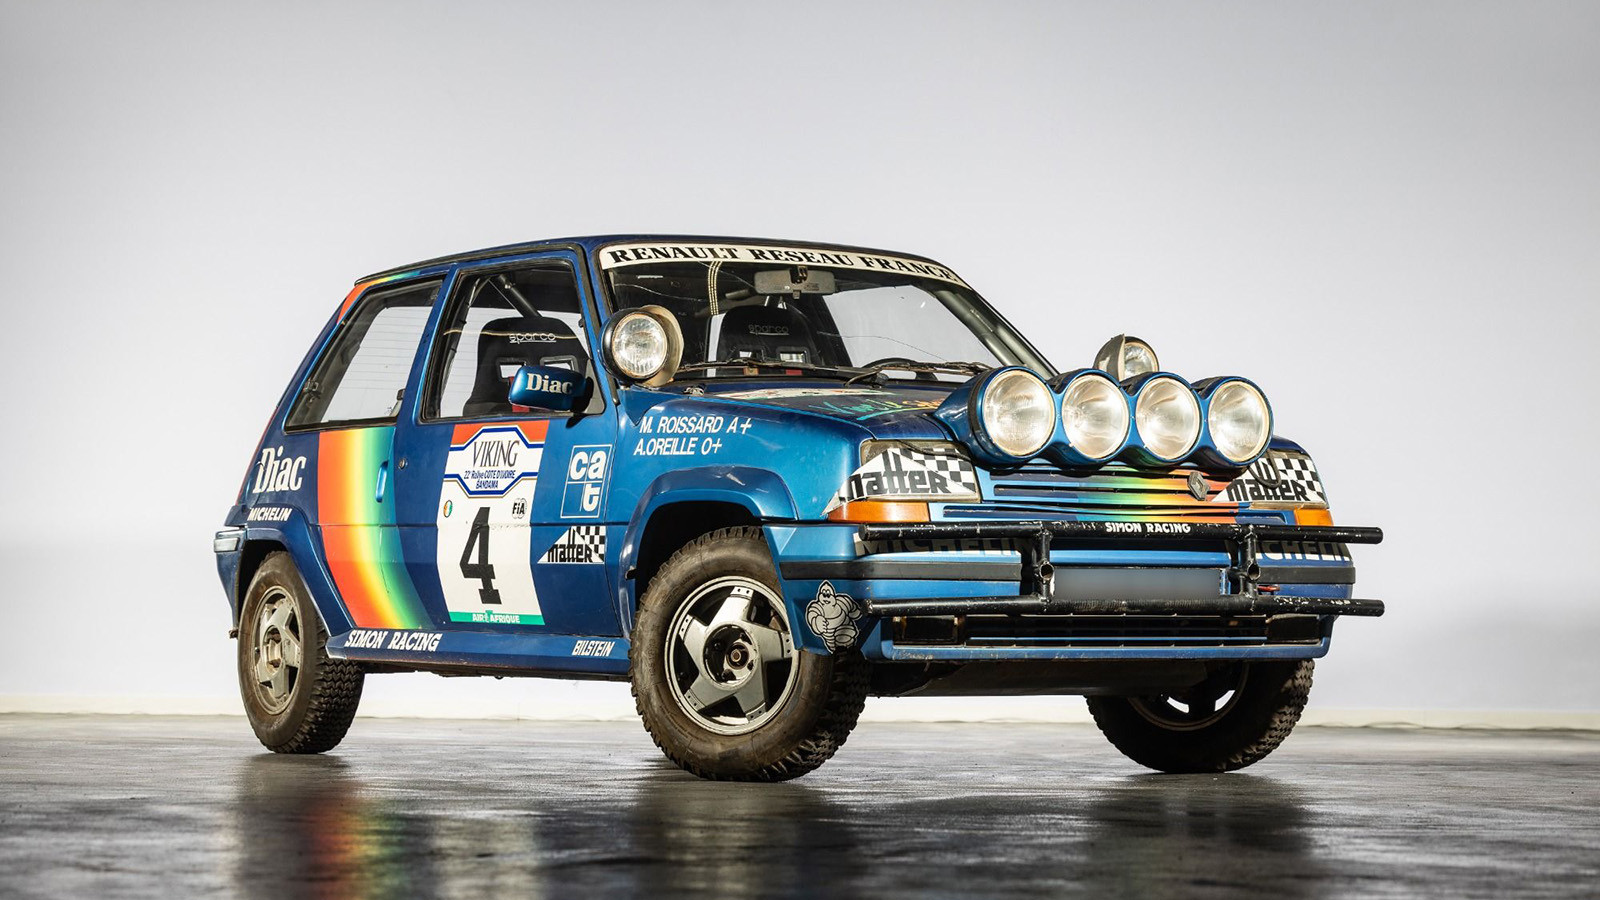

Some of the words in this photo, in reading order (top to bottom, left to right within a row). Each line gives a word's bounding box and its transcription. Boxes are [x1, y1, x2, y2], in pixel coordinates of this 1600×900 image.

[607, 246, 739, 264] RENAULT
[746, 249, 854, 267] RESEAU
[857, 256, 959, 282] FRANCE
[509, 333, 557, 344] sparco
[748, 324, 789, 336] sparco
[525, 373, 573, 395] Diac
[639, 416, 653, 434] M.
[657, 416, 724, 434] ROISSARD
[473, 440, 520, 467] VIKING
[633, 437, 698, 456] A.OREILLE
[252, 445, 307, 493] Diac
[476, 480, 499, 490] BANDAMA
[247, 506, 292, 521] MICHELIN
[1104, 522, 1142, 533] SIMON
[1146, 523, 1191, 533] RACING
[460, 507, 502, 604] 4
[490, 614, 520, 624] AFRIQUE
[344, 630, 388, 649] SIMON
[387, 631, 443, 652] RACING
[571, 640, 615, 657] BILSTEIN
